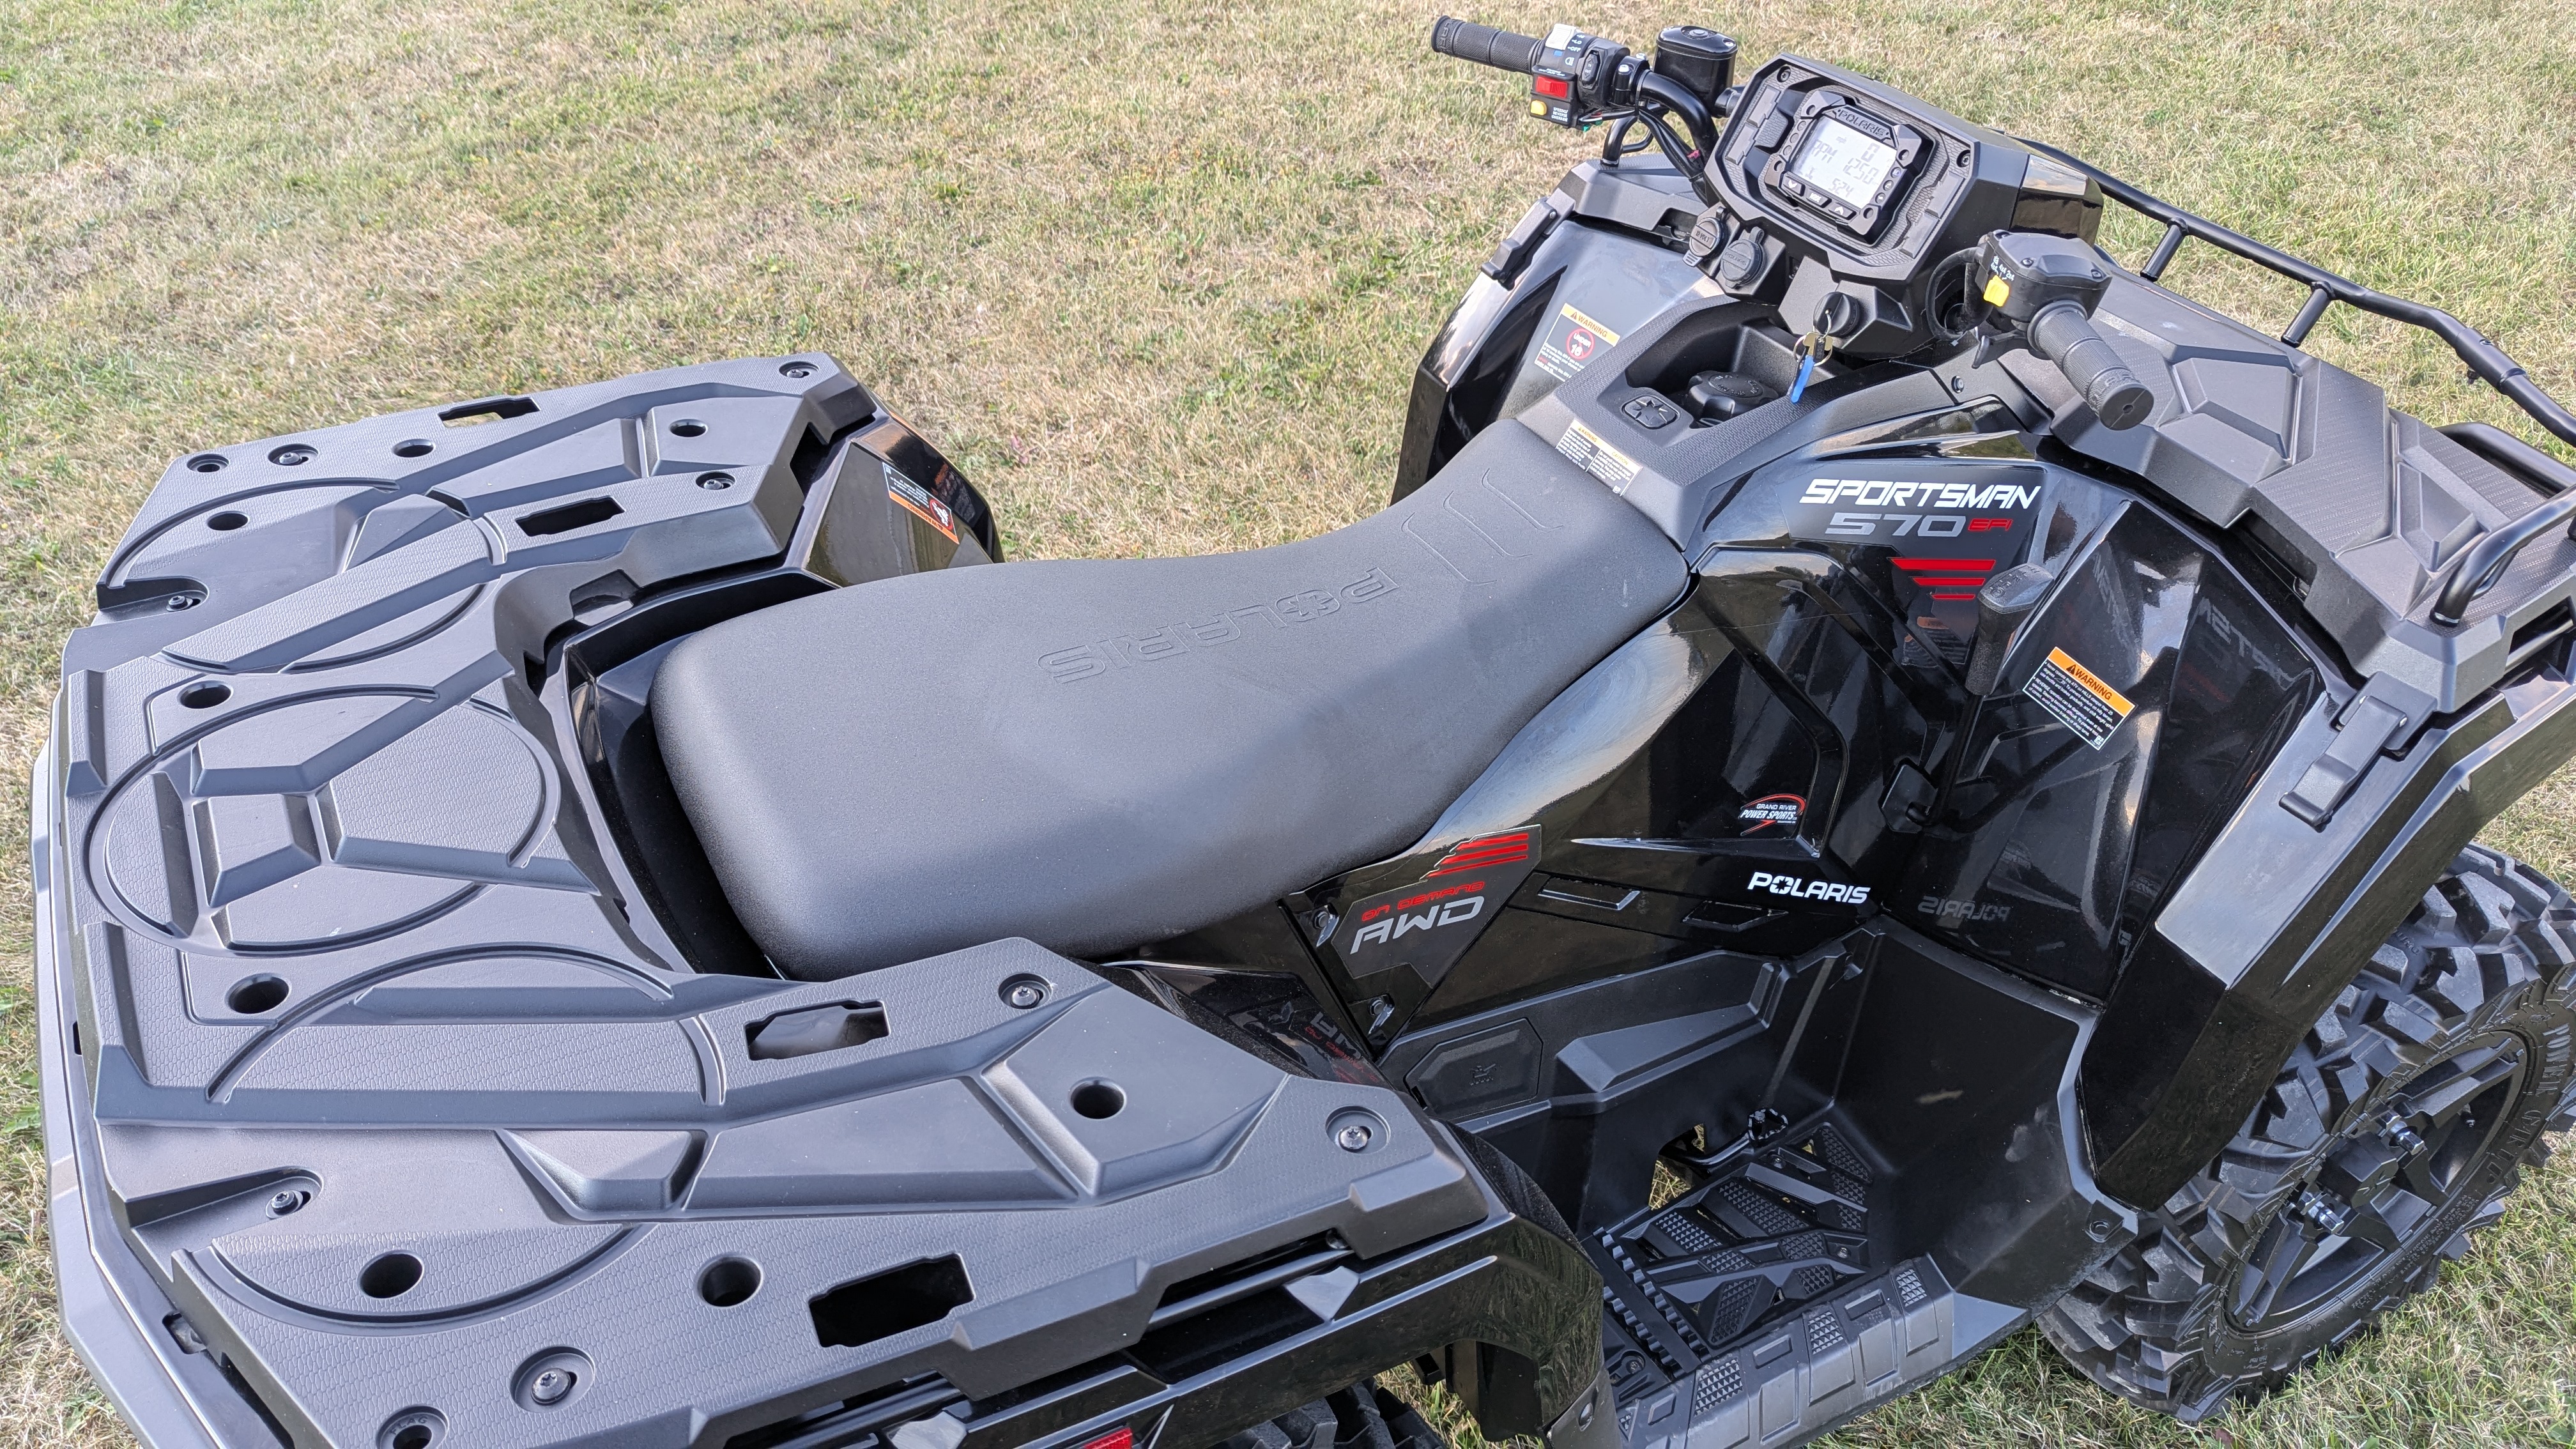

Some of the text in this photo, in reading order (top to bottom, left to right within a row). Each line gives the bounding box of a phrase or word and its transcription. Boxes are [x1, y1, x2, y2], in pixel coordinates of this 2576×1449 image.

[1838, 109, 1887, 137] POLARIS
[1811, 141, 1879, 185] RPM 1250
[1578, 315, 1608, 337] WARNING
[1611, 452, 1629, 466] CAUTION
[1799, 479, 2041, 509] SPORTSMAN
[1825, 512, 2014, 537] 570 EFI
[1037, 567, 1400, 684] POLARIS
[2074, 668, 2113, 700] WARNING
[2081, 689, 2091, 698] HILLS
[1740, 809, 1796, 820] POWER SPORTS
[1747, 871, 1871, 904] POLARIS
[1350, 896, 1484, 954] AWD
[390, 1416, 427, 1435] FLAG
